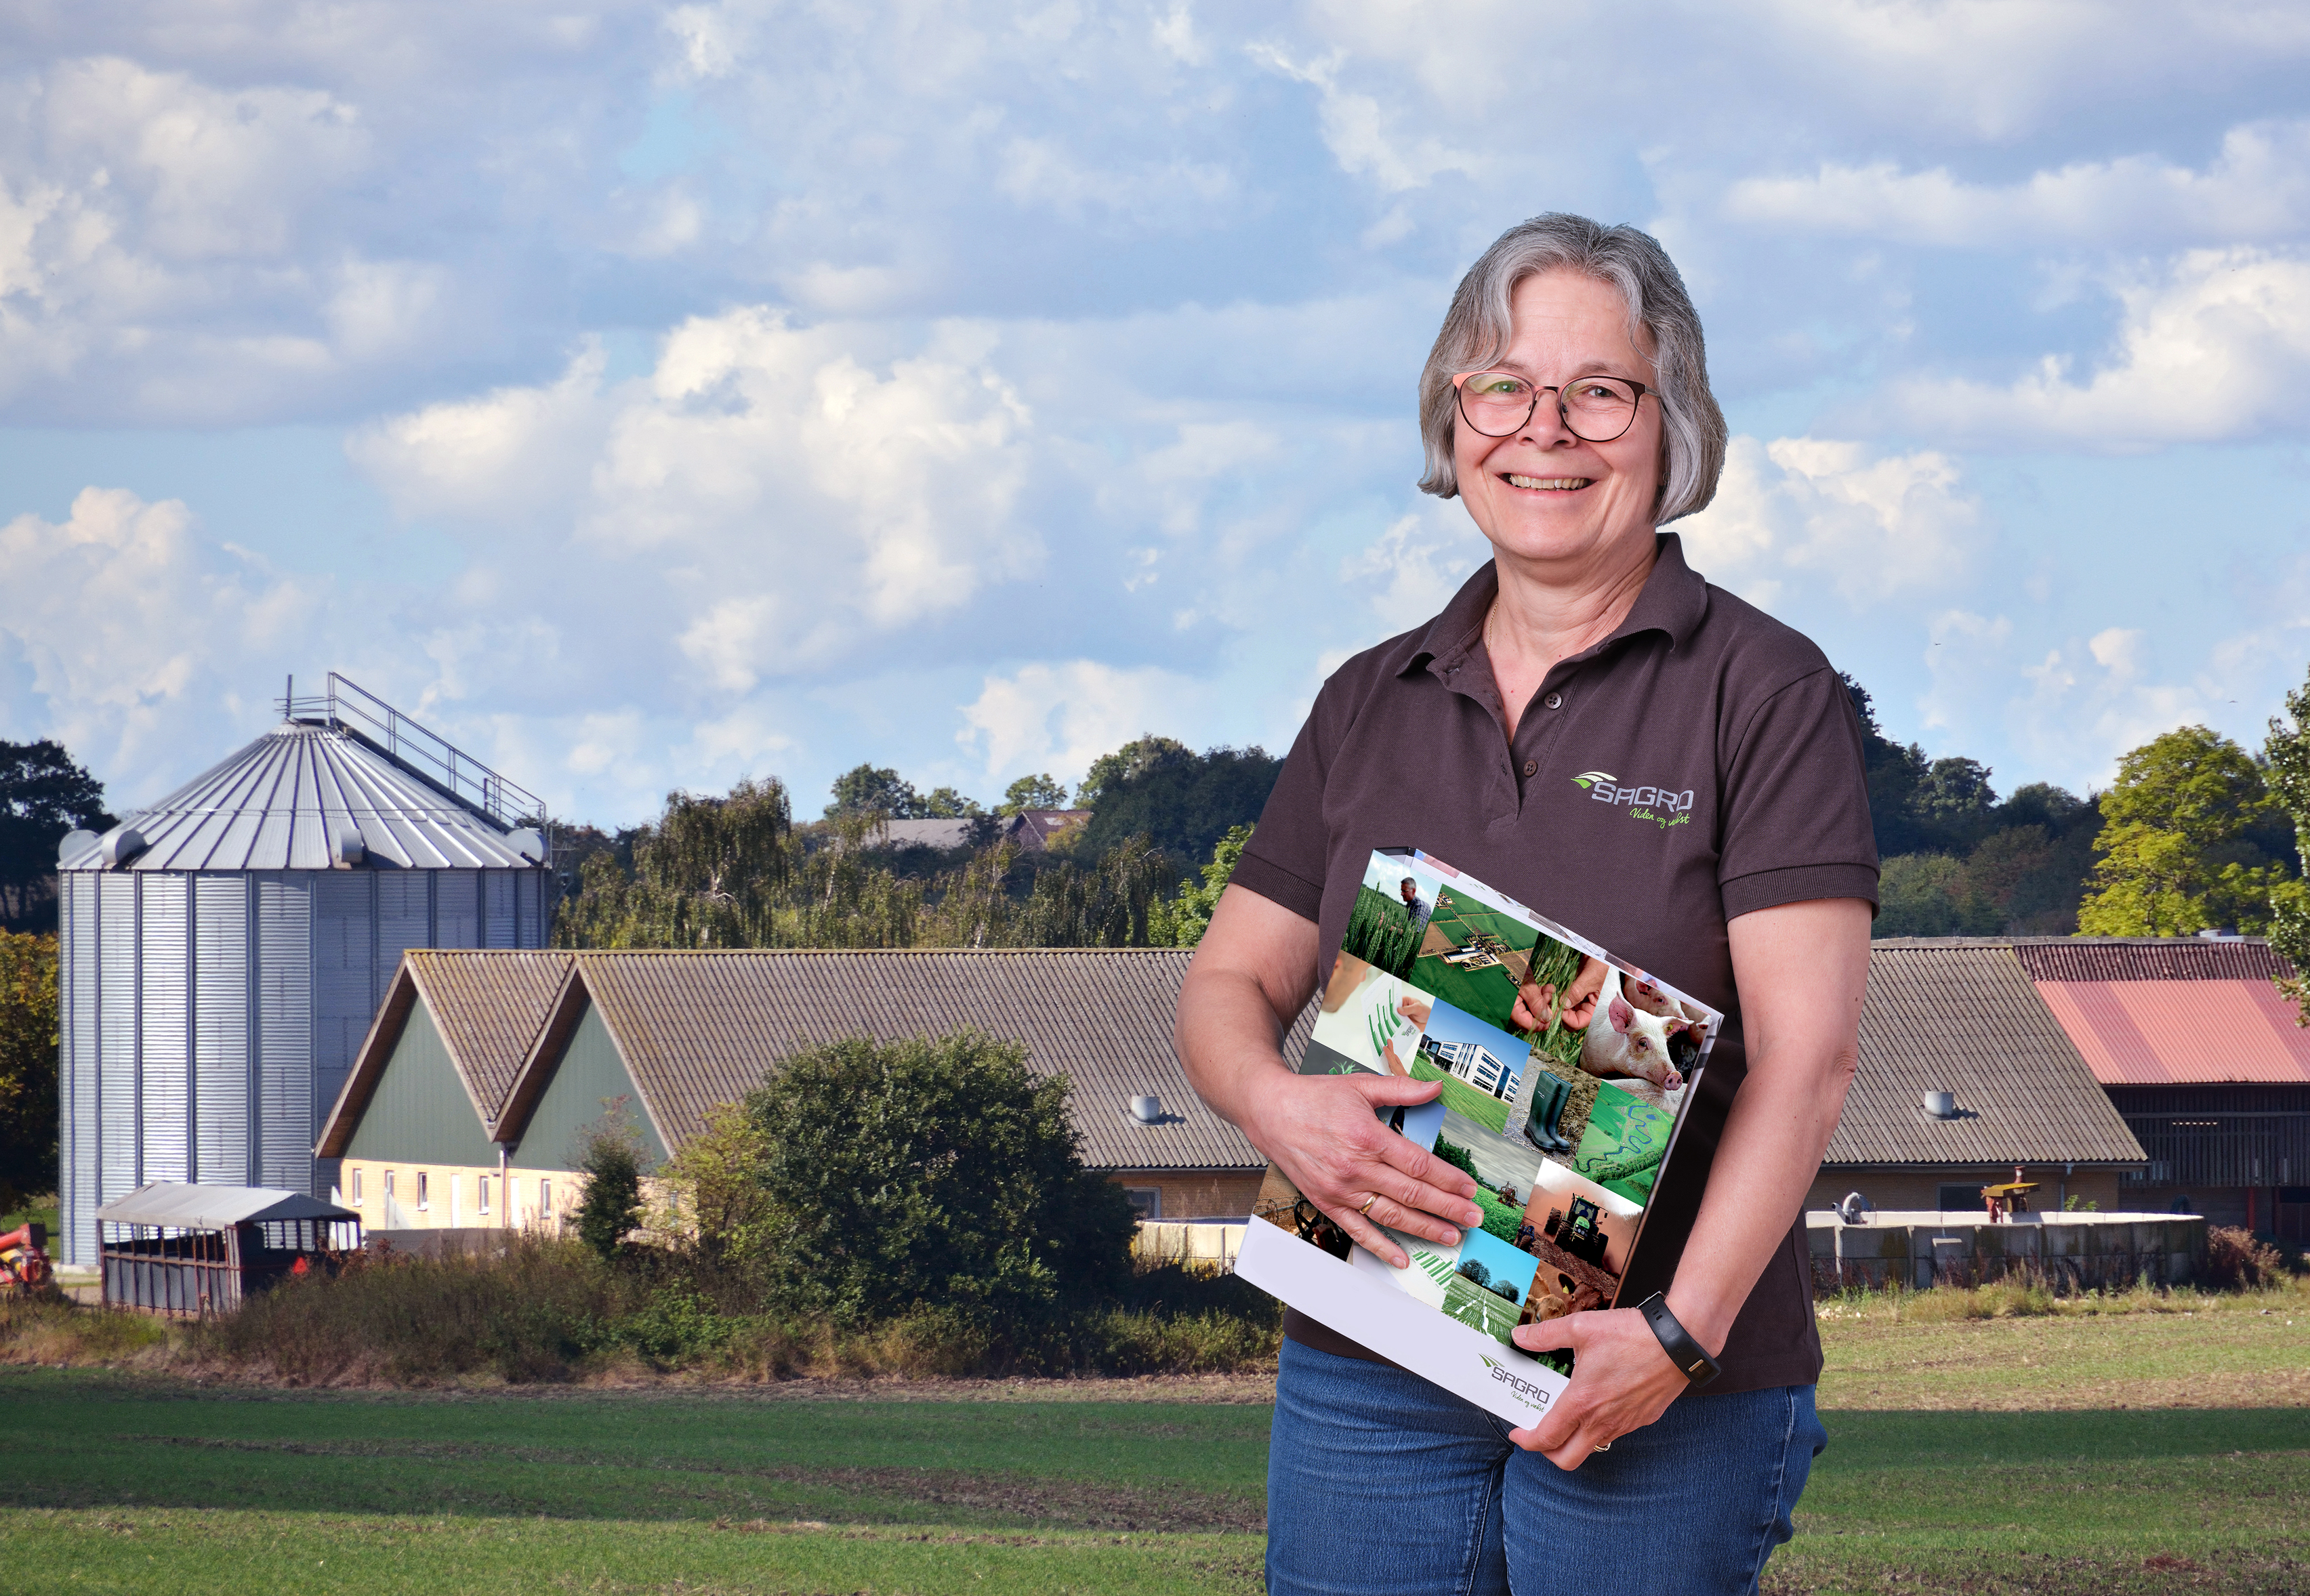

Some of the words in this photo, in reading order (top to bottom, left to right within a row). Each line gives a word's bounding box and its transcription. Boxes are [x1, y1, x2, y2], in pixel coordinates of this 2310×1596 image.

[1592, 782, 1694, 812] SAGRO
[1630, 807, 1654, 820] Viden
[1657, 817, 1666, 828] og
[1377, 1225, 1401, 1246] SAGRO
[1491, 1366, 1550, 1404] SAGRO
[1511, 1391, 1523, 1402] Viden
